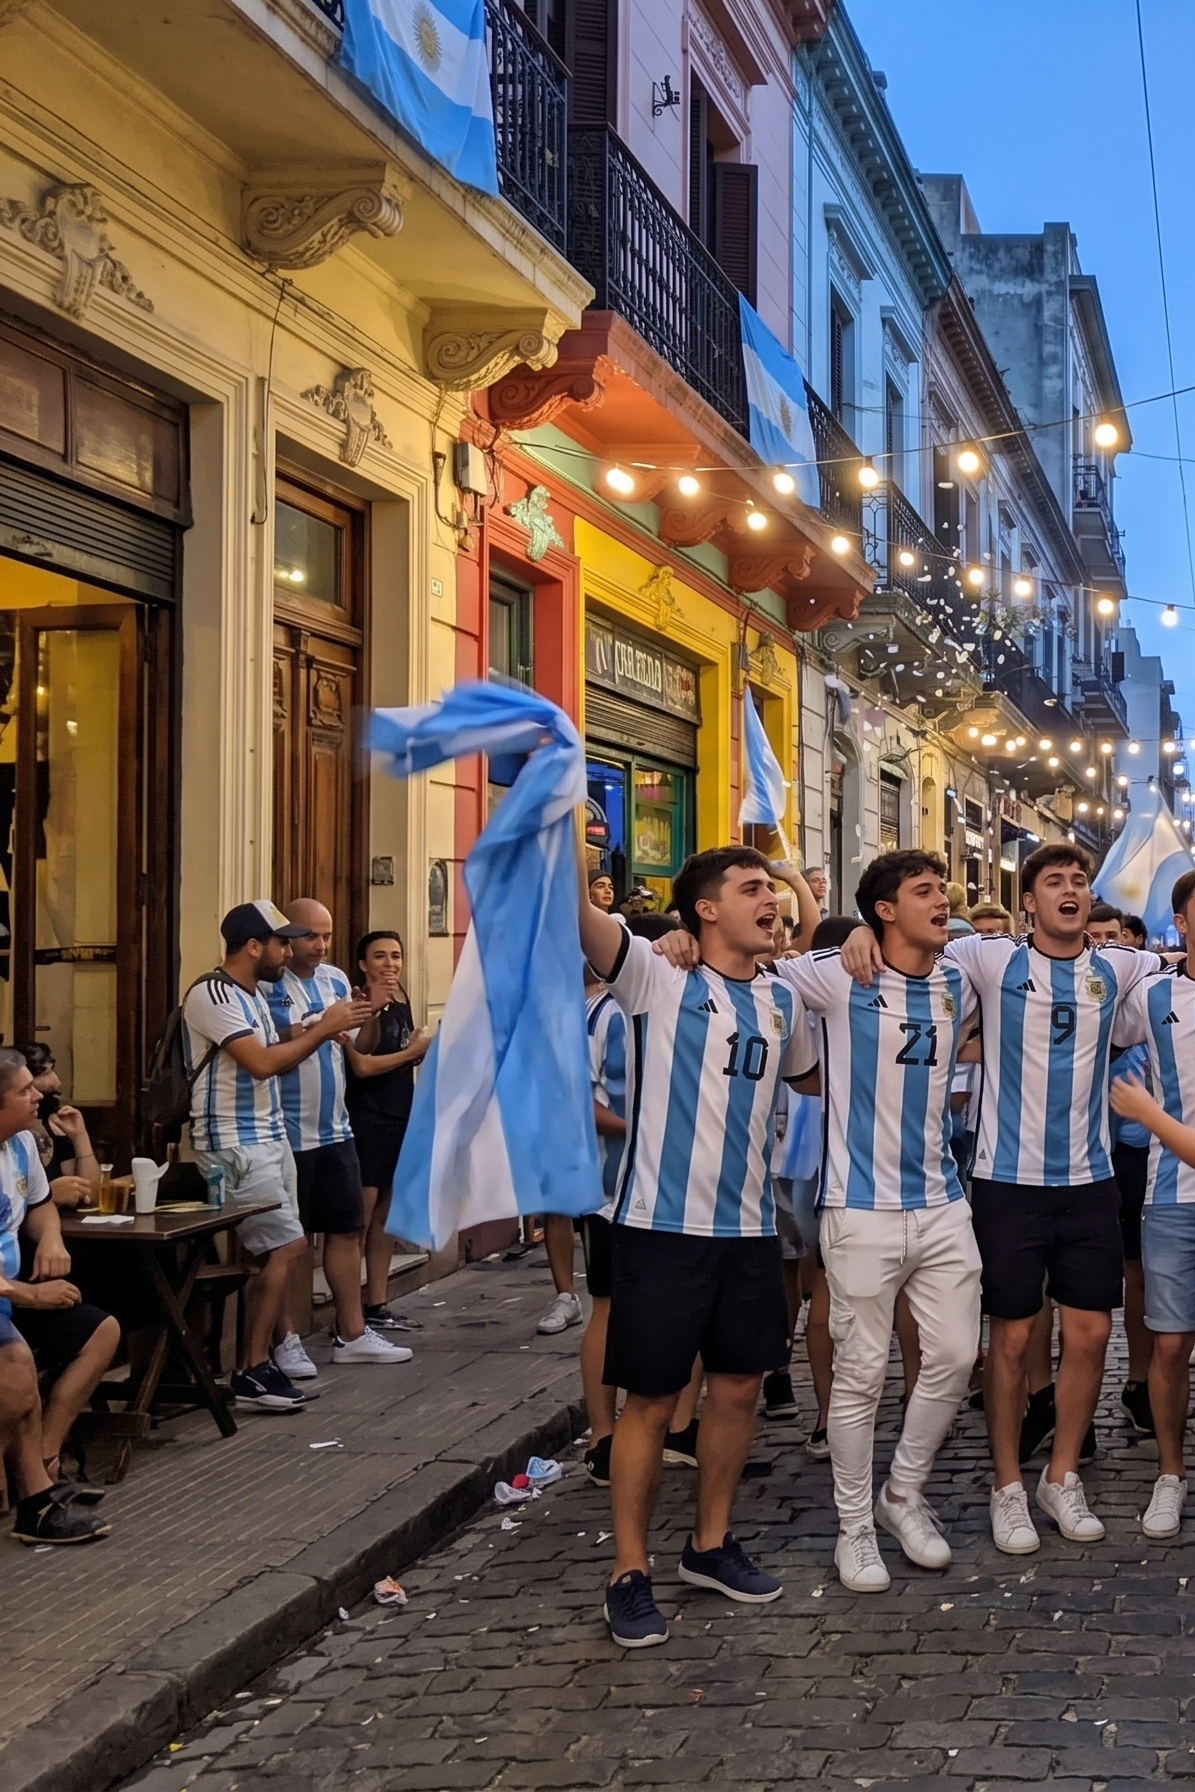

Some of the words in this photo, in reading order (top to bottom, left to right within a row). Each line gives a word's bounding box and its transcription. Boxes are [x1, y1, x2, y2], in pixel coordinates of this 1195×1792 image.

[895, 1022, 938, 1067] 21
[1051, 1005, 1075, 1045] 9
[722, 1031, 769, 1081] 10
